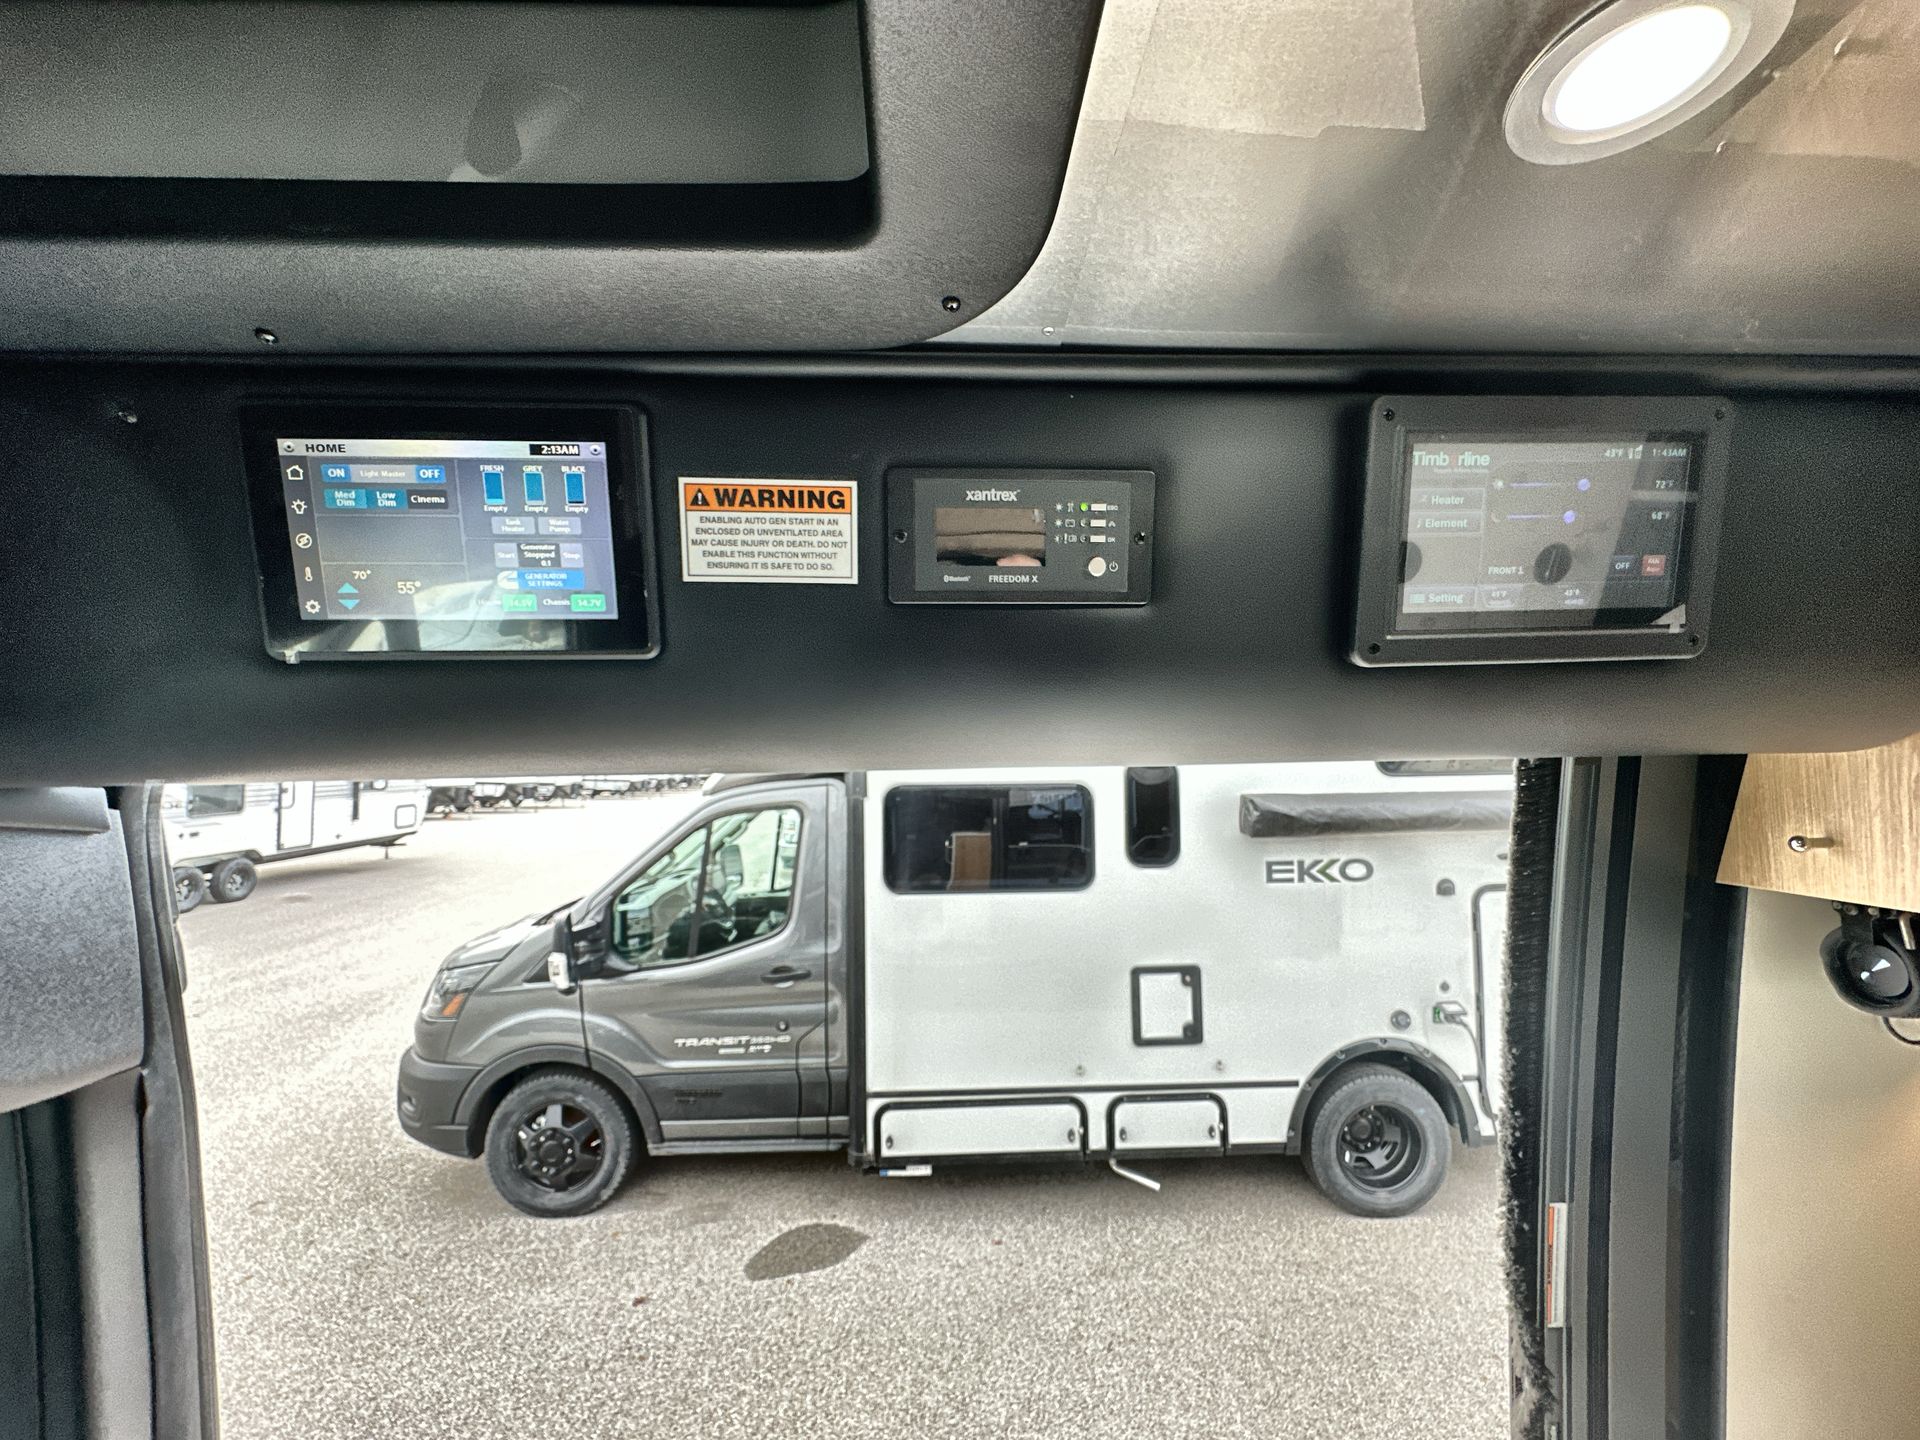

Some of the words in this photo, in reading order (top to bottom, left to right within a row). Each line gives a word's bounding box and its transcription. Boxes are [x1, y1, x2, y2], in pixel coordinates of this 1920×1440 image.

[305, 443, 347, 453] HOME
[541, 446, 579, 454] 2:13AM
[1412, 452, 1490, 467] Timbrline
[328, 468, 345, 478] ON
[360, 470, 379, 478] Light
[420, 469, 440, 479] OFF
[334, 491, 356, 499] Med
[376, 491, 396, 500] Low
[410, 495, 446, 504] Cinema
[714, 488, 846, 510] WARNING
[965, 488, 1018, 502] xantrex
[1431, 496, 1465, 505] Heater
[484, 505, 508, 513] Empty
[699, 516, 742, 524] ENABLING
[744, 516, 767, 525] AUTO
[769, 517, 786, 525] GEN
[1425, 519, 1468, 528] Element
[695, 527, 740, 536] ENCLOSED
[757, 528, 818, 537] UNVENTILATED
[352, 569, 372, 580] 70°
[1488, 566, 1516, 575] FRONT
[988, 575, 1029, 583] FREEDOM
[1032, 575, 1038, 583] X
[396, 580, 422, 594] 55°
[1428, 593, 1464, 604] Setting
[1265, 858, 1374, 884] EKKO
[674, 1035, 750, 1048] TRANSIT
